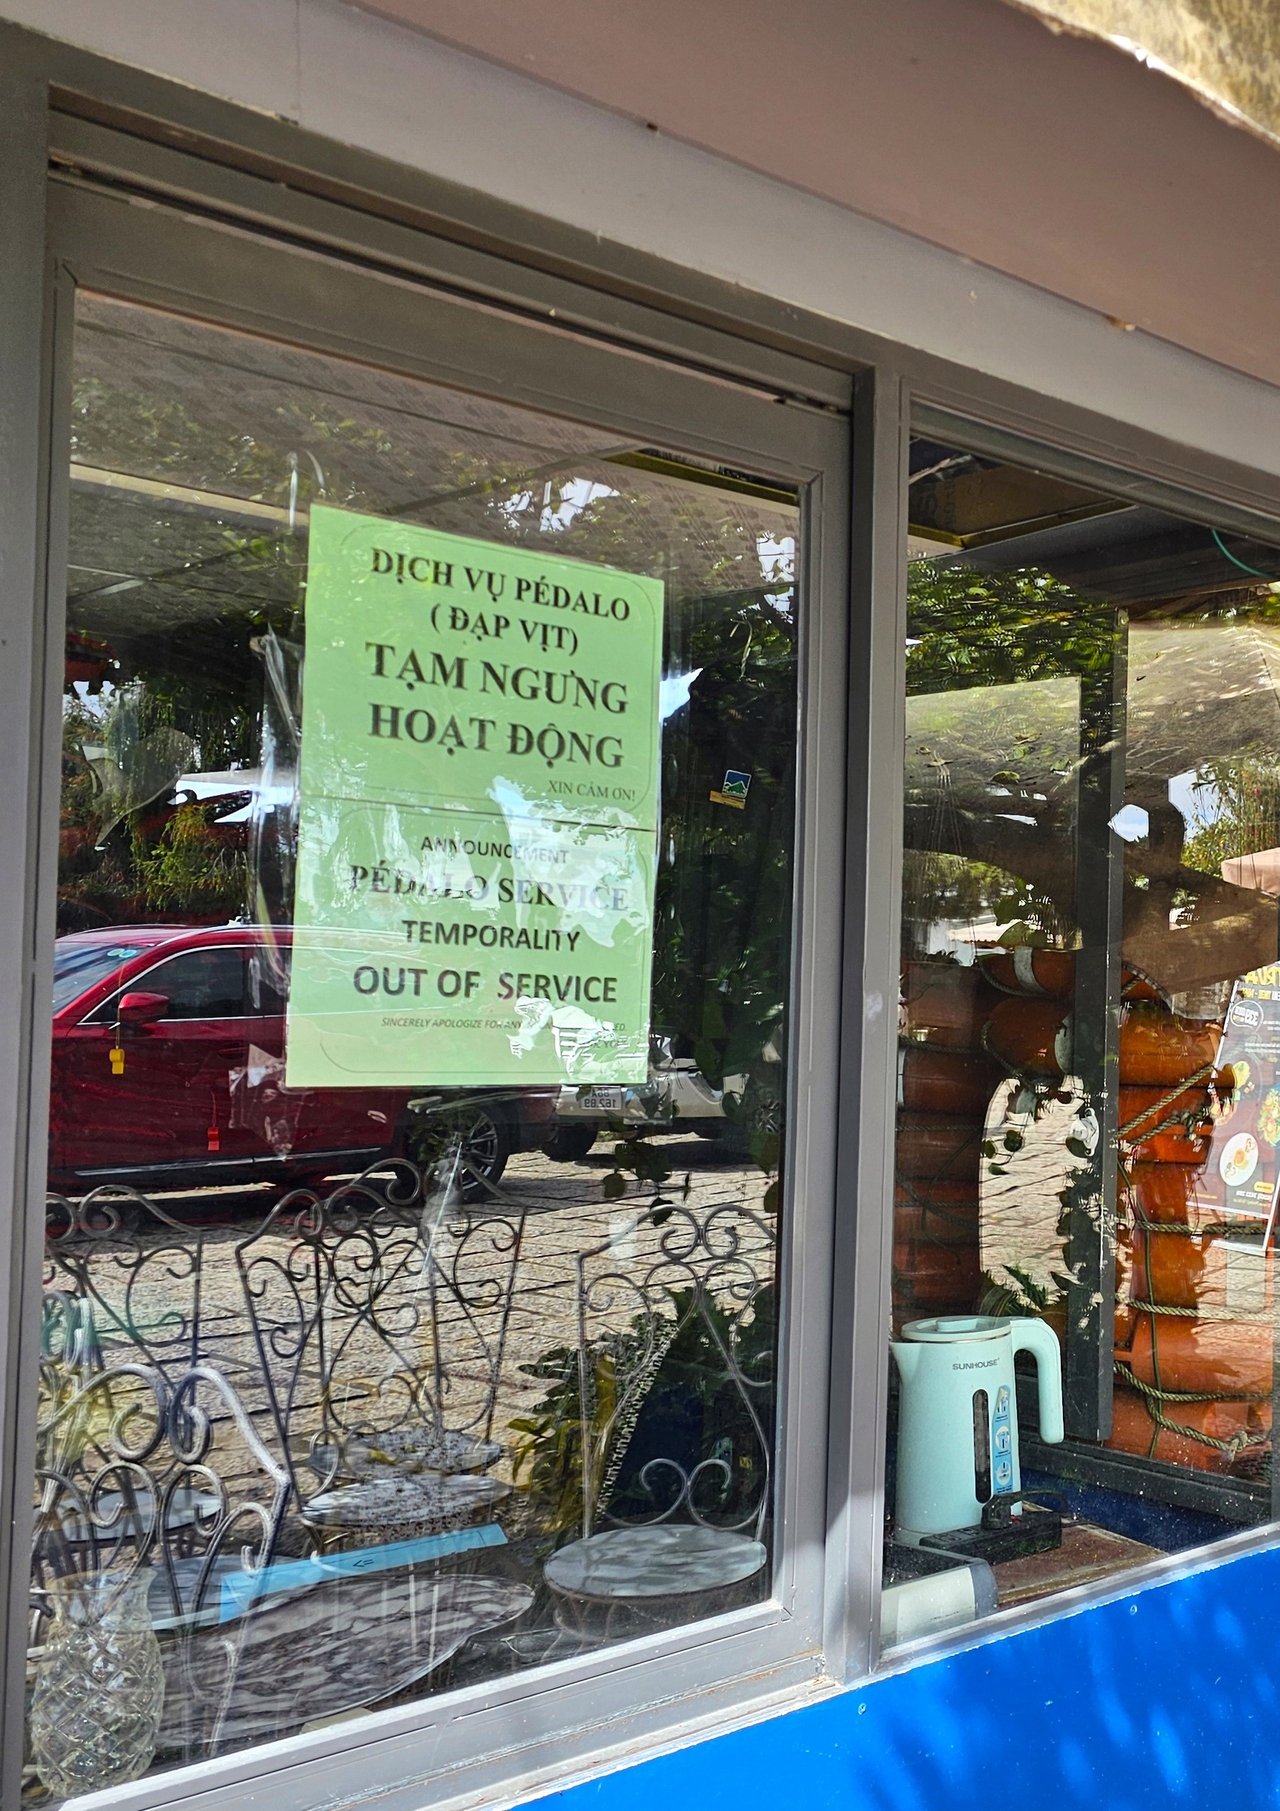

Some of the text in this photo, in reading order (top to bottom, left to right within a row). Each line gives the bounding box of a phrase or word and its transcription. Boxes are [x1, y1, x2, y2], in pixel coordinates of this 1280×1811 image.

[370, 547, 631, 621] DỊCH VỤ PÉDALO
[448, 606, 510, 642] ĐẠP
[519, 619, 579, 656] VỊT)
[364, 641, 629, 714] TẠM NGƯNG
[368, 702, 625, 769] HOẠT ĐỘNG
[547, 780, 573, 795] XIN
[420, 836, 570, 864] ANNOUNCEMENT
[349, 859, 629, 912] PÉDALO SERVICE
[401, 919, 581, 952] TEMPORALITY
[353, 965, 618, 1003] OUT OF SERVICE
[380, 1017, 430, 1028] SINCERELY
[432, 1018, 482, 1029] APOLOGIZE
[952, 1360, 998, 1371] SUNHOUSE
